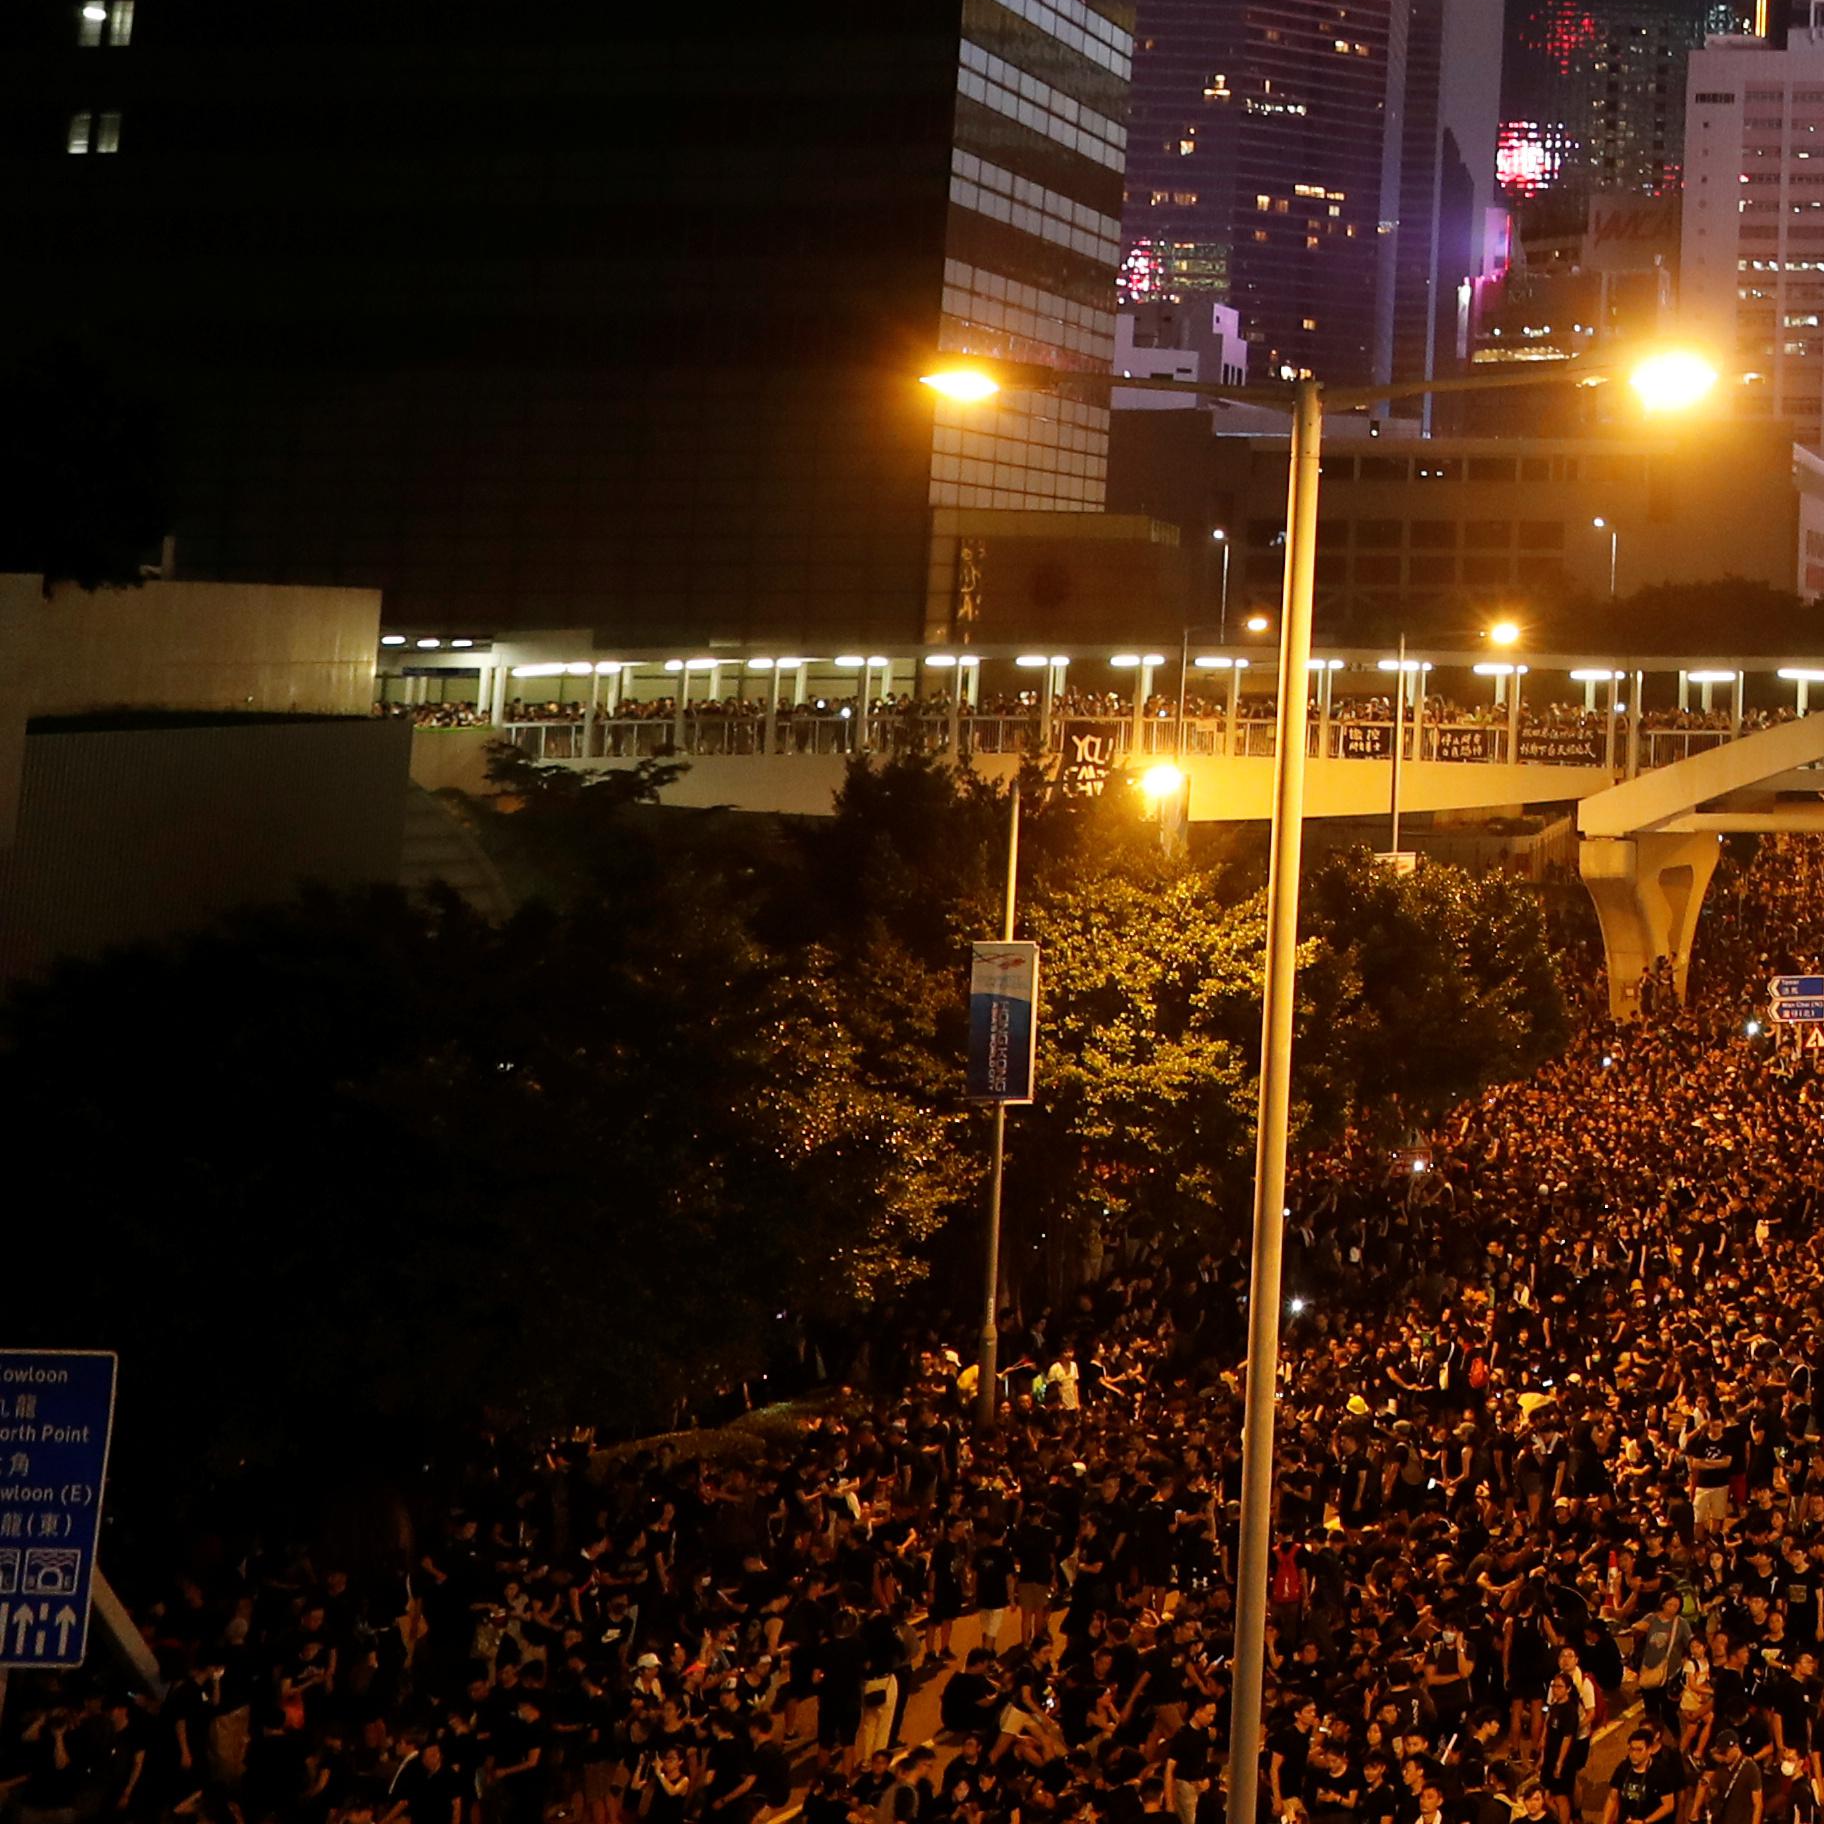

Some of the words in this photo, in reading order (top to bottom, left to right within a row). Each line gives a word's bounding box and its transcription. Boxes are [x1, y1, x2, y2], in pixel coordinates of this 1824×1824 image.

[0, 1366, 68, 1384] owloon
[0, 1424, 36, 1442] orth
[41, 1424, 91, 1444] Point
[0, 1452, 30, 1477] 角
[61, 1484, 93, 1506] (E)
